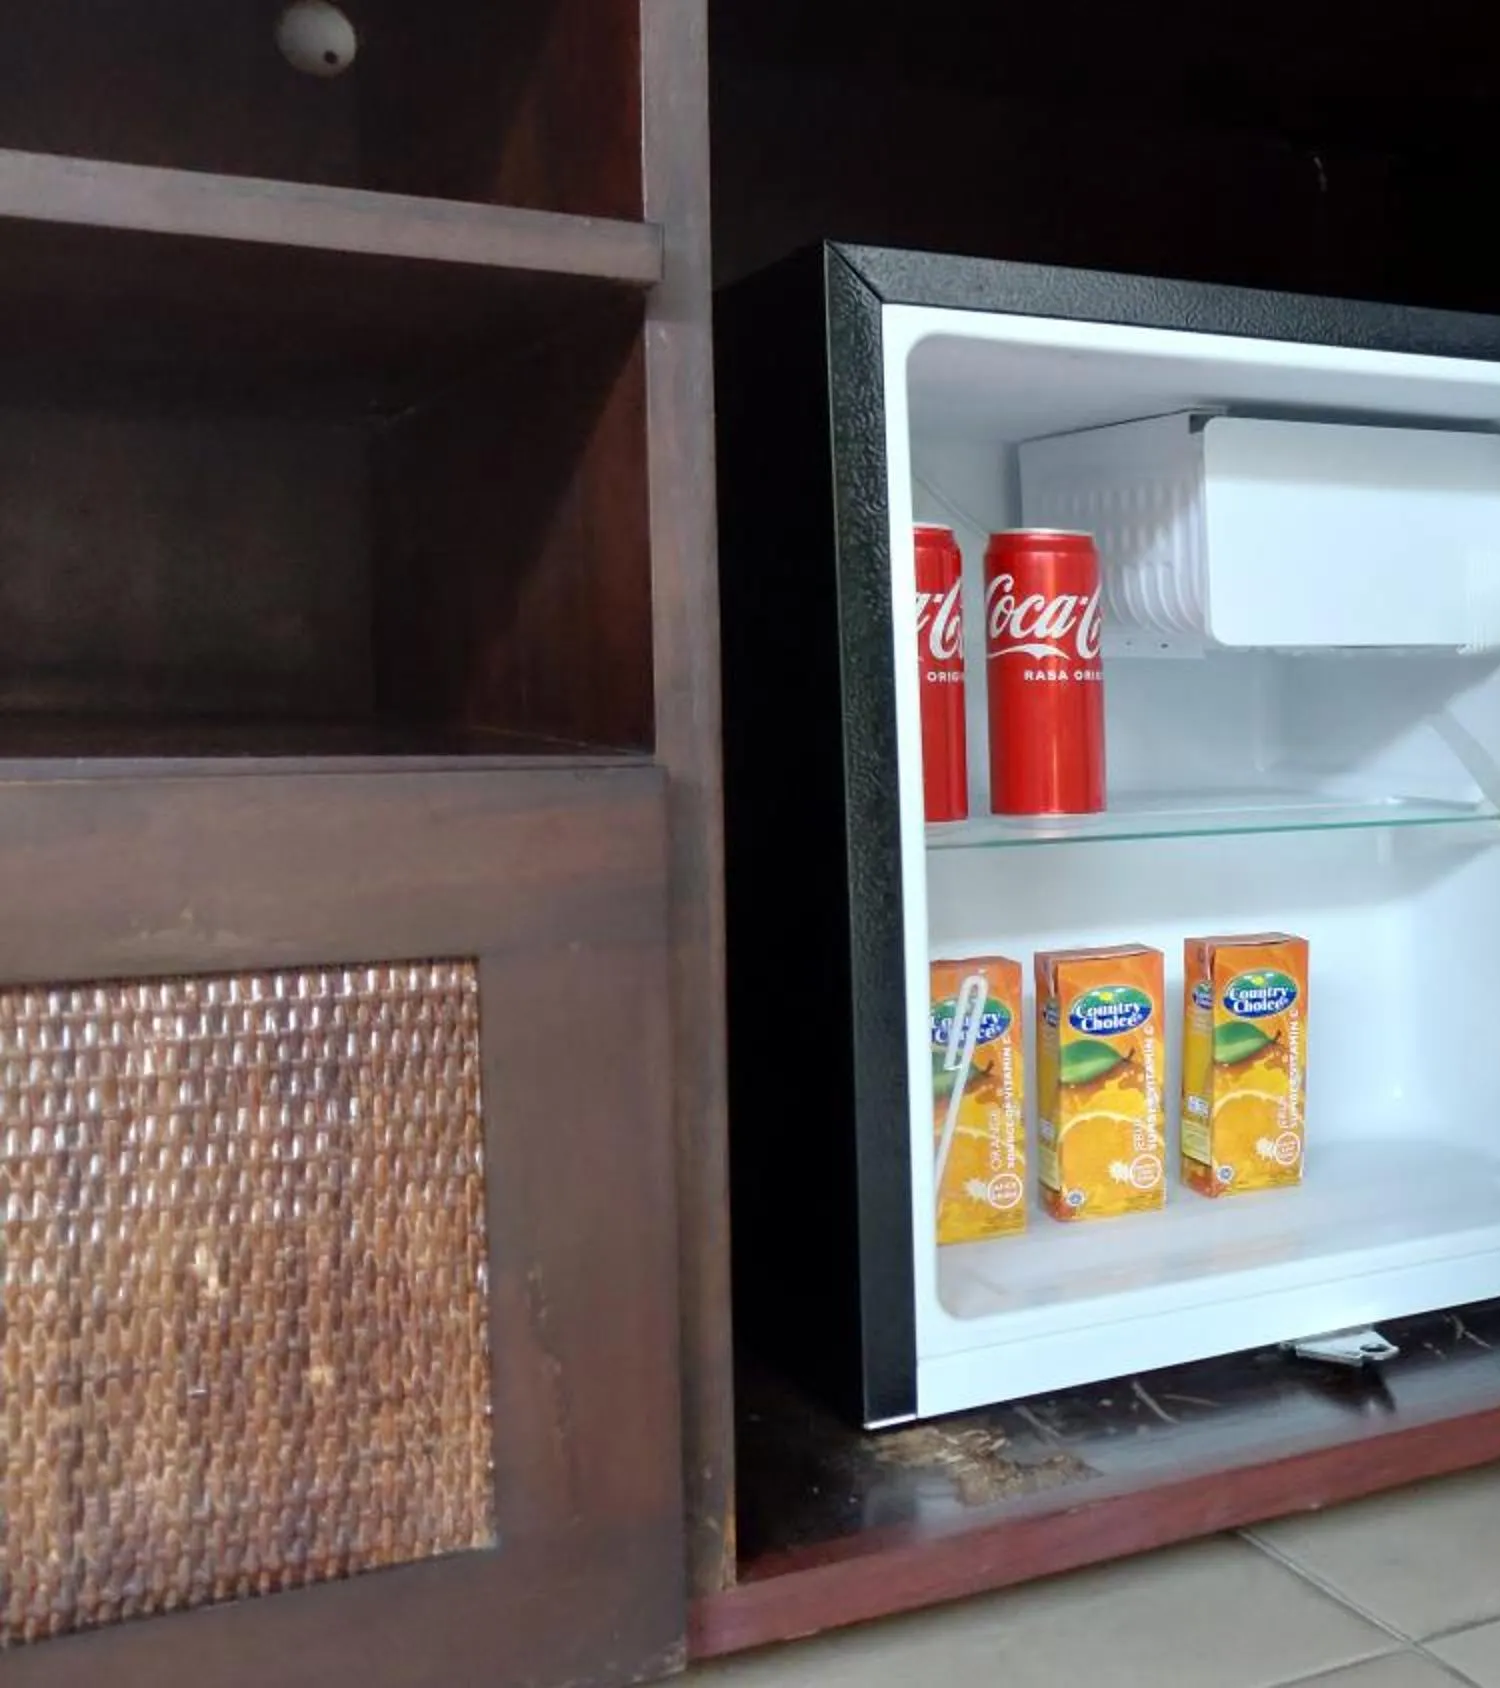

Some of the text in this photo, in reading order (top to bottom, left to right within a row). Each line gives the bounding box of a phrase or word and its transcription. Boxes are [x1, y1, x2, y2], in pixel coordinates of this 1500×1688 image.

[1024, 670, 1069, 681] RASA
[1229, 986, 1289, 1001] Country
[1075, 1002, 1140, 1019] Country
[1233, 998, 1286, 1013] Choice
[1081, 1014, 1138, 1031] Choice
